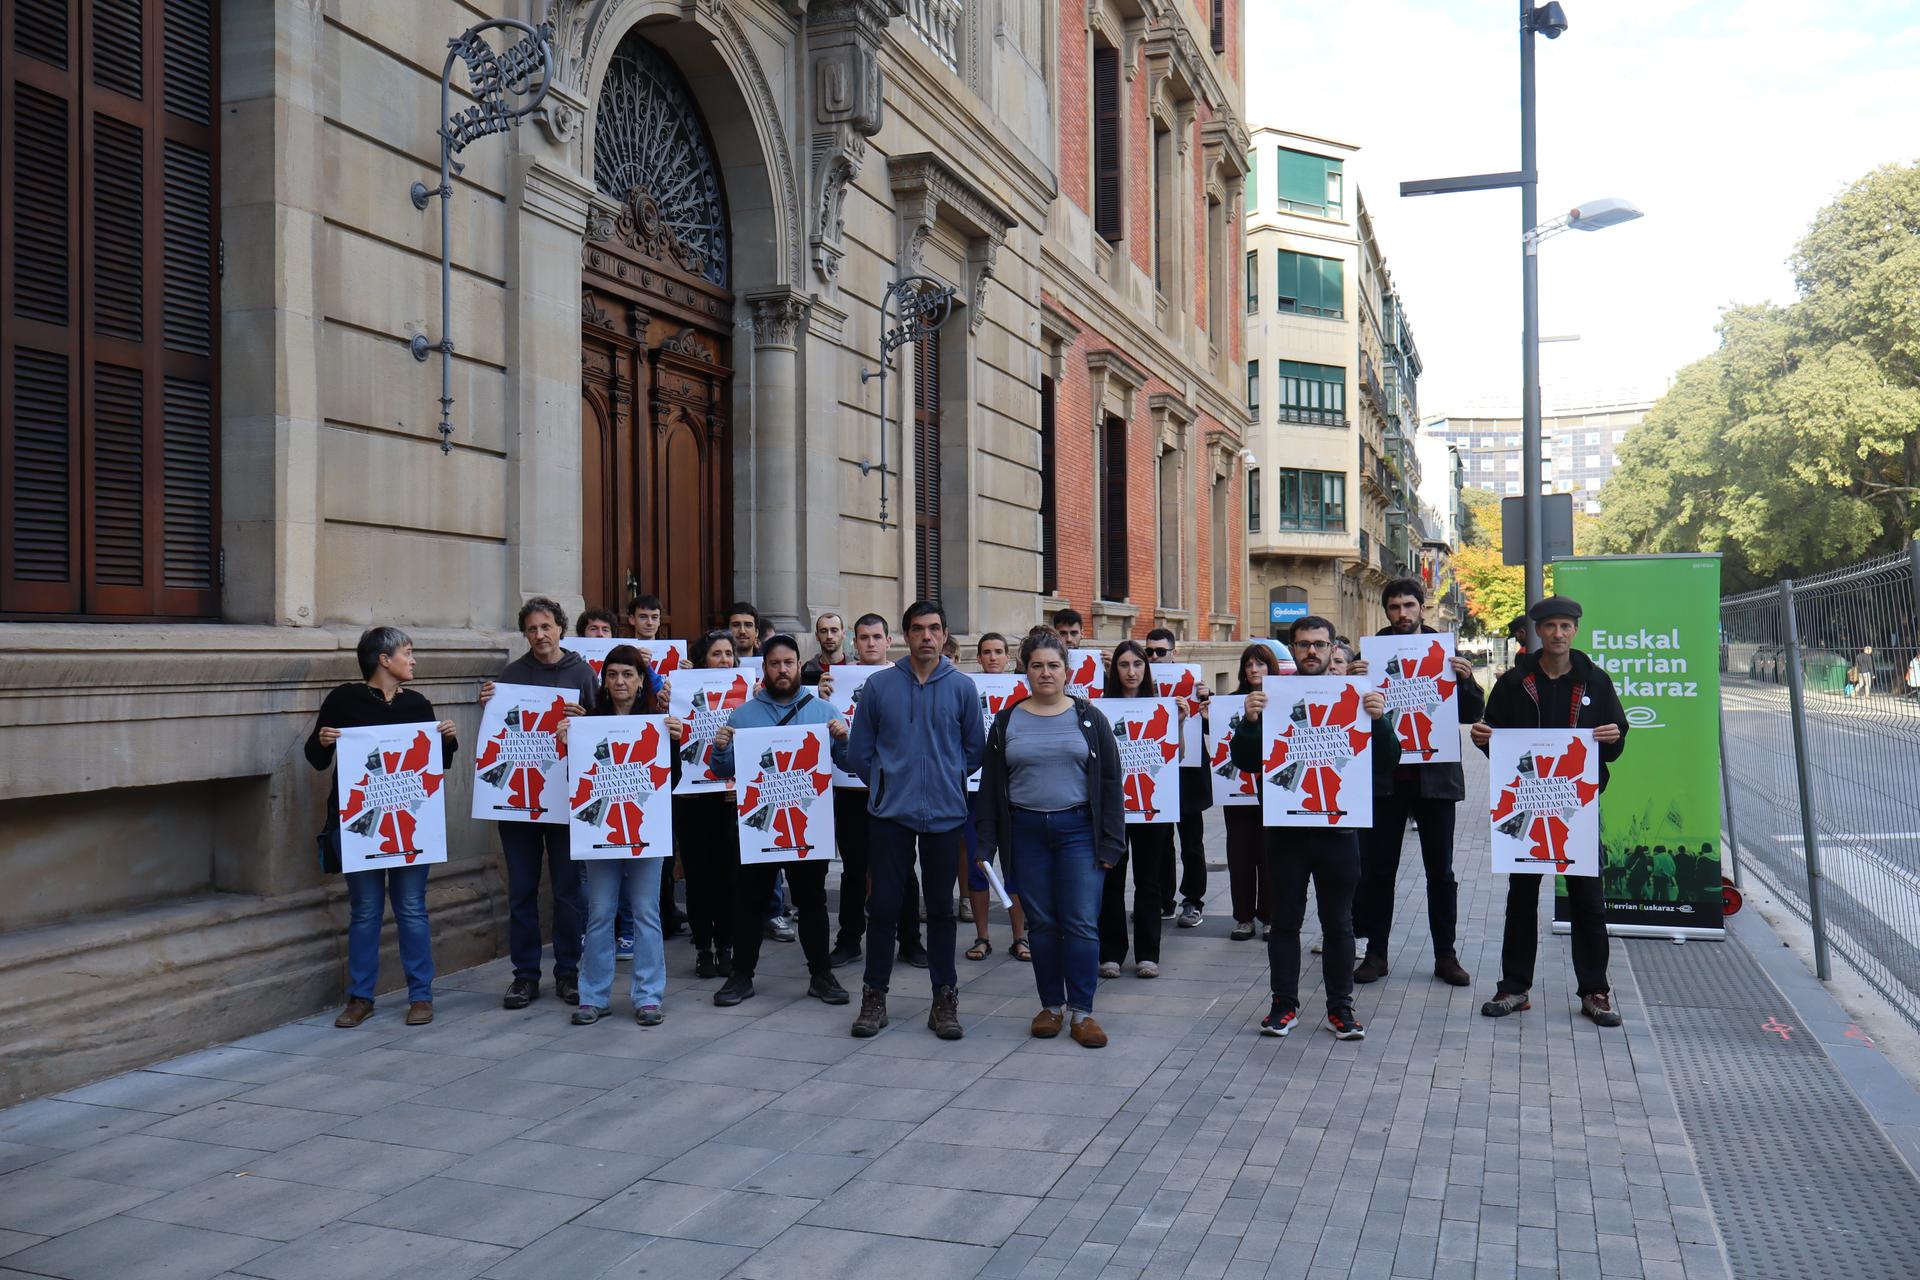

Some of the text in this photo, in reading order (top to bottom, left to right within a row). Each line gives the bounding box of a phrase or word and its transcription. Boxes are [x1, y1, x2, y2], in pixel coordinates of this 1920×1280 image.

[1592, 629, 1680, 649] Euskal
[1588, 653, 1686, 673] Herrian
[1389, 677, 1430, 687] EUSKARARI
[1615, 676, 1697, 696] skaraz
[1385, 683, 1437, 695] LEHENTASUNA
[1386, 690, 1437, 701] EMANEN DION
[690, 716, 729, 726] LEHENTASU
[690, 731, 716, 739] OFIZIAL
[1293, 726, 1340, 736] EUSKARARI
[1120, 739, 1154, 747] USKARARI
[1288, 734, 1348, 745] LEHENTASUNA
[1120, 745, 1160, 754] HENTASUNA
[1290, 741, 1348, 752] EMANEN DION
[1120, 754, 1142, 762] ANEN
[597, 763, 641, 773] EUSKARARI
[369, 771, 414, 785] EUSKARARI
[592, 770, 650, 782] LEHENTASUNA
[762, 770, 804, 781] EUSKARARI
[365, 777, 422, 793] LEHENTASUNA
[594, 777, 650, 790] EMANEN DION
[759, 776, 812, 789] LEHENTASUNA
[1521, 777, 1567, 787] EUSKARARI
[366, 785, 422, 800] EMANEN DION
[760, 786, 791, 796] EMANEN
[1516, 784, 1576, 795] LEHENTASUNA
[1517, 792, 1576, 802] EMANEN DION
[1608, 902, 1637, 910] Herrian
[1639, 904, 1674, 912] Euskaraz
